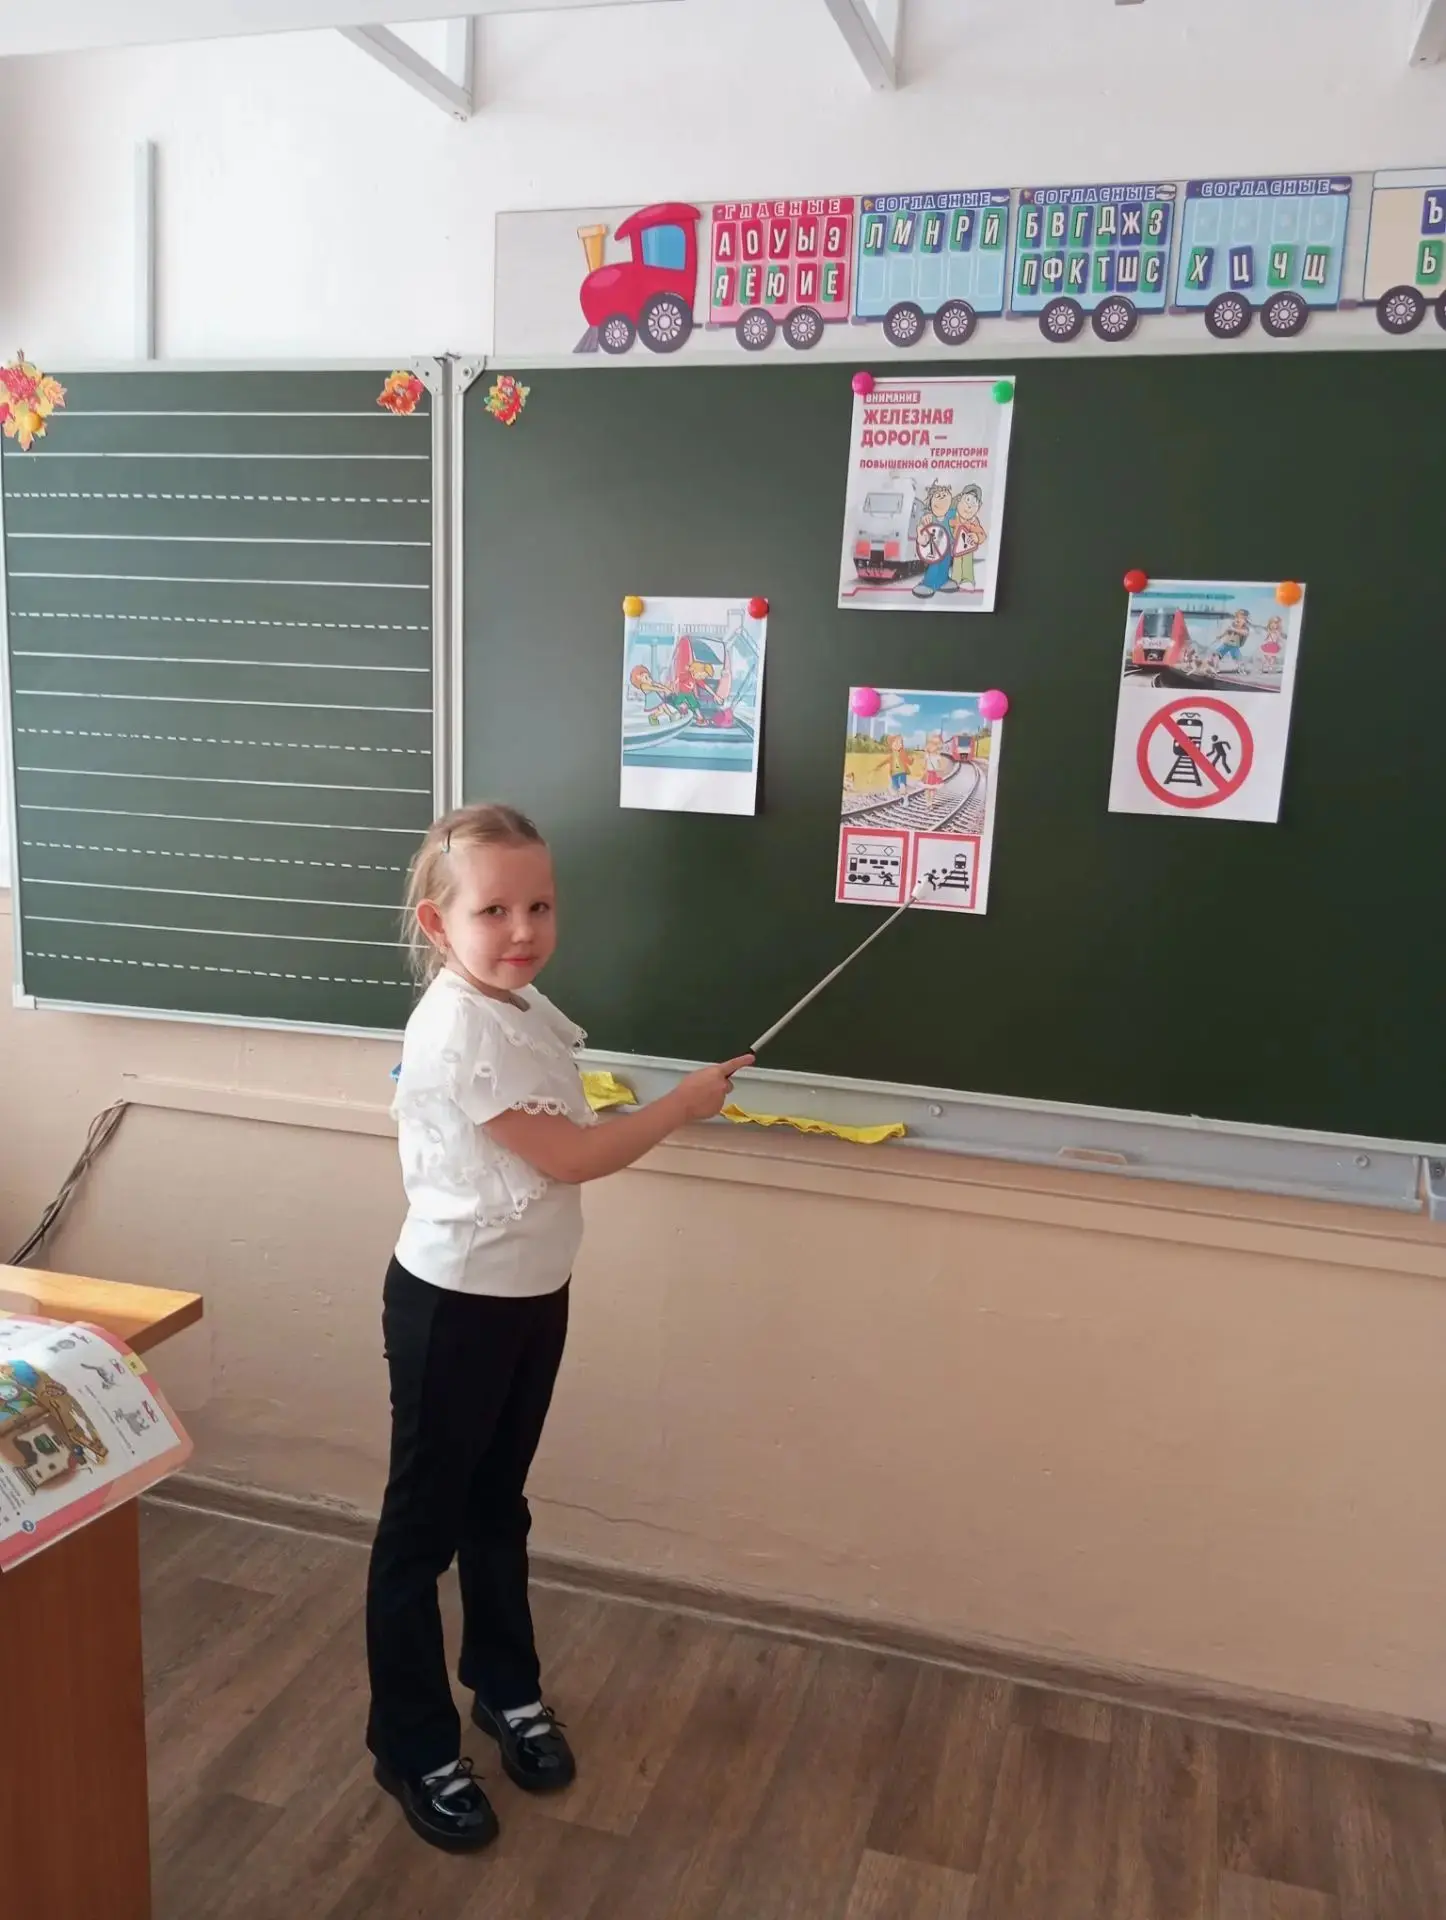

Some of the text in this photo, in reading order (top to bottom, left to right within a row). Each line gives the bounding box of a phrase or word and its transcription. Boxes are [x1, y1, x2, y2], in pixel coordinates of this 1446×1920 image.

[1034, 186, 1155, 204] СОГЛАСНЫЕ
[1202, 180, 1330, 196] СОГЛАСНЫЕ
[725, 200, 841, 219] ГЛАСНЫЕ
[876, 192, 992, 210] СОГЛАСНЫЕ
[866, 215, 998, 248] Л М Н Р Й
[719, 226, 840, 256] А О У Ы Э
[716, 268, 838, 299] Я Ё Ю И Е
[866, 392, 918, 404] ВНИМАНИЕ
[863, 408, 953, 425] ЖЕЛЕЗНАЯ
[861, 430, 929, 447] ДОРОГА
[930, 448, 989, 457] ТЕРРИТОРИЯ
[860, 458, 987, 469] ПОВЫШЕННОЙ ОПАСНОСТИ
